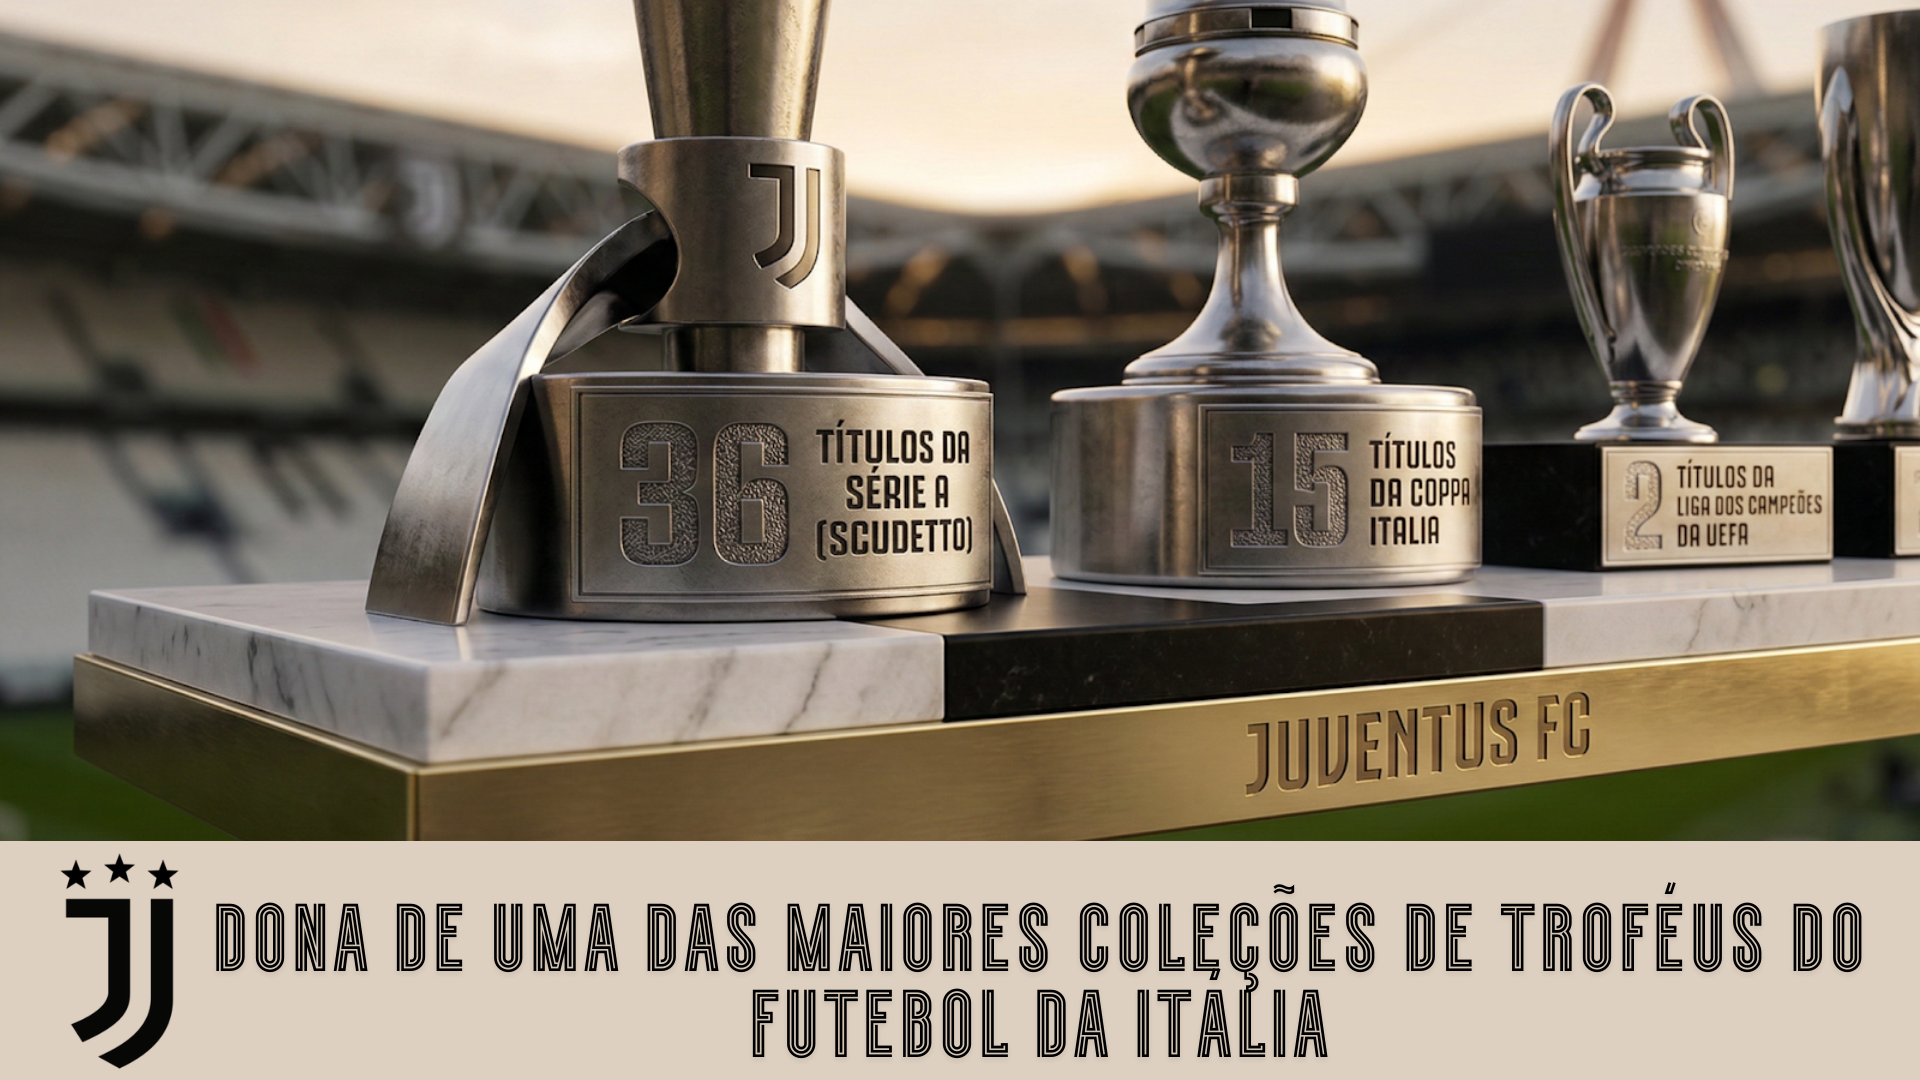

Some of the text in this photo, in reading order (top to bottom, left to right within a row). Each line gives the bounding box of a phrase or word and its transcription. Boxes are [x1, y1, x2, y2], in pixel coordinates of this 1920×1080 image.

[815, 419, 970, 465] TÍTULOS DA
[1369, 432, 1456, 469] TÍTULOS
[620, 421, 790, 567] 36
[845, 465, 950, 510] SÉRIE A
[1230, 432, 1349, 548] 15
[1370, 477, 1471, 507] DA COPPA
[1676, 459, 1775, 489] TÍTULOS DA
[1623, 460, 1662, 551] 2
[1677, 490, 1823, 517] LIGA DOS CAMPEÕES
[816, 516, 973, 561] (SCUDETTO)
[1370, 516, 1440, 546] ITALIA
[1677, 522, 1749, 548] DA UEFA
[1245, 691, 1590, 797] JUVENTUS FC
